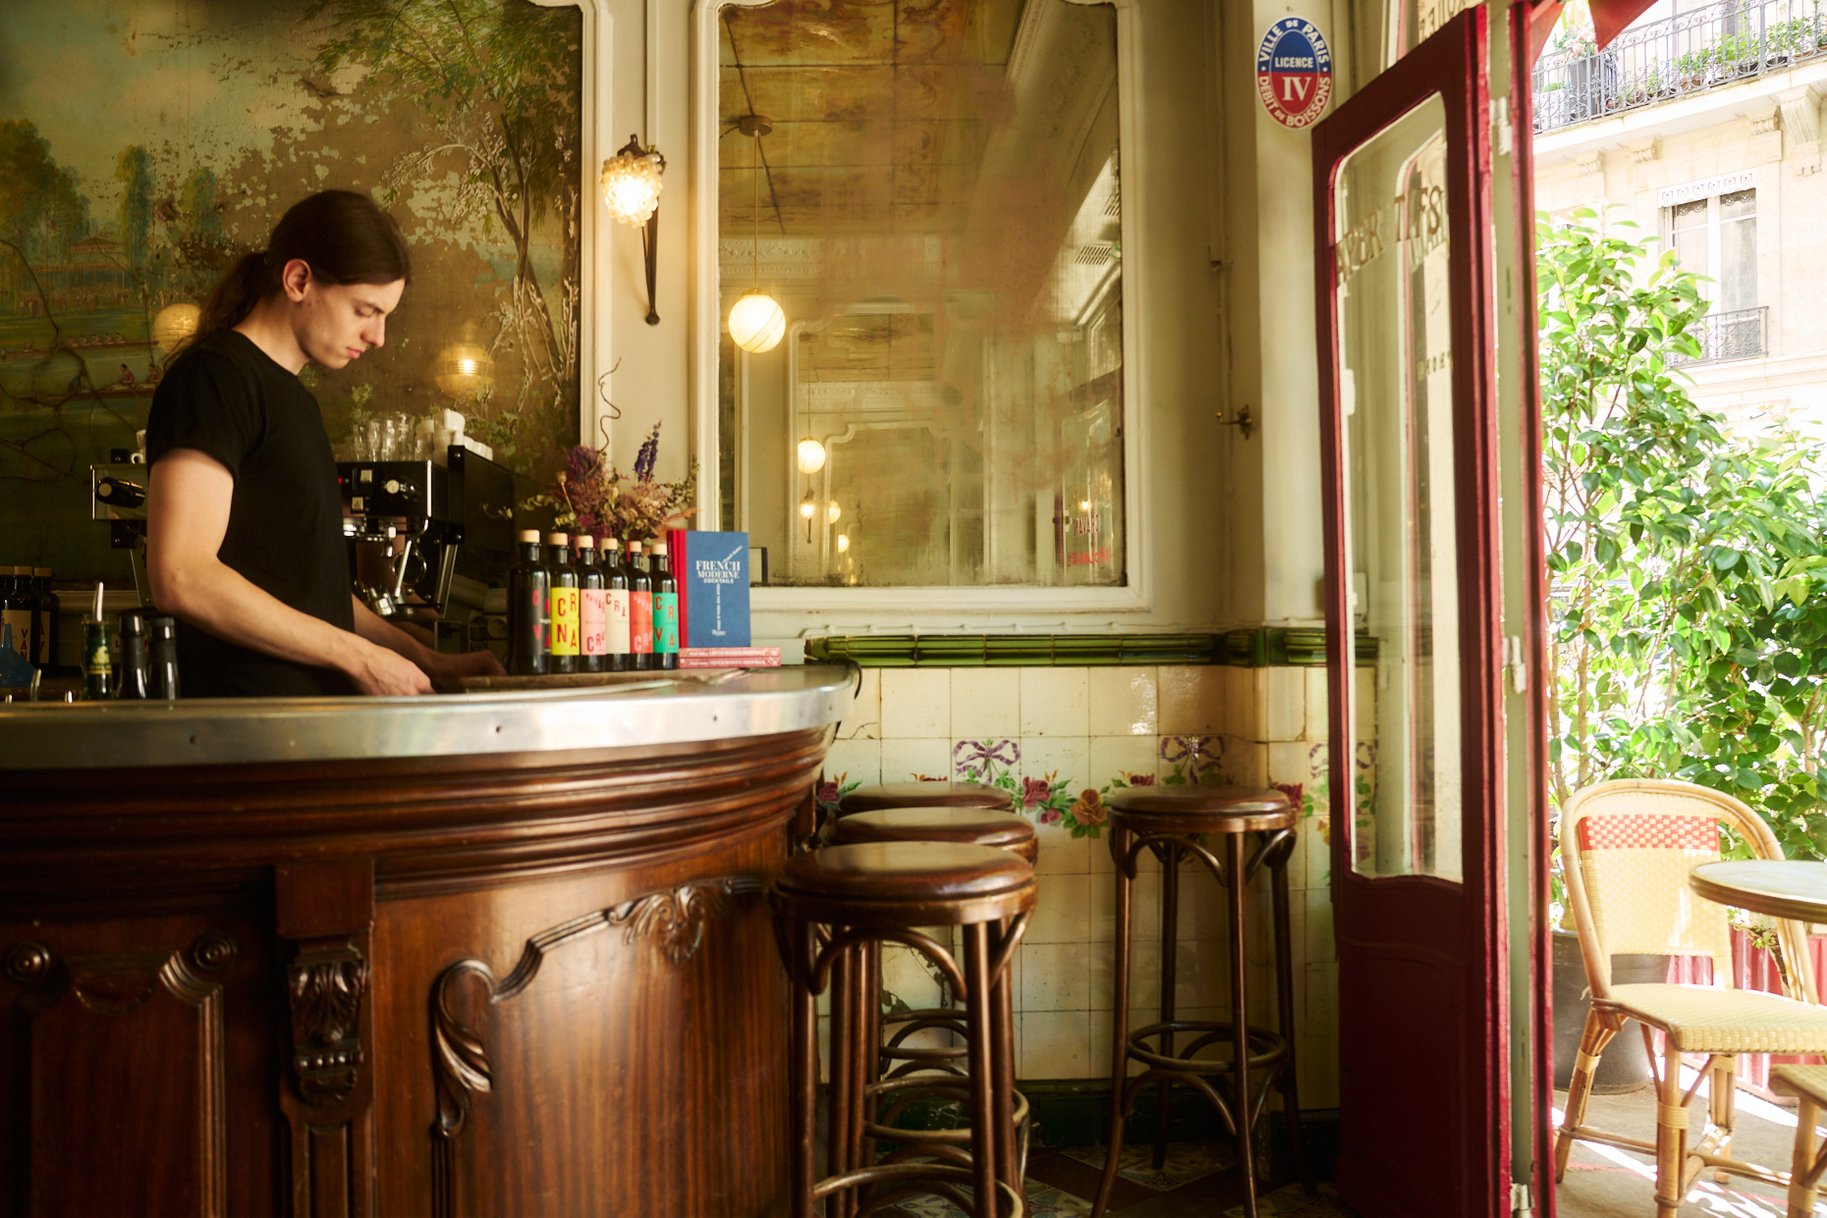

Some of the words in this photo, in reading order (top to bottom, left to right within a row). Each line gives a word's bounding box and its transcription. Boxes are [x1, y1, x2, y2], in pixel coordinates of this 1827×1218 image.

[1260, 26, 1283, 61] VILLE
[1286, 20, 1298, 28] DE
[1302, 24, 1329, 63] PARIS
[1275, 57, 1314, 68] LICENCE
[1282, 76, 1312, 101] IV
[1286, 77, 1330, 126] BOISSONS
[696, 560, 741, 573] FRENCH
[697, 570, 740, 579] MODERNE
